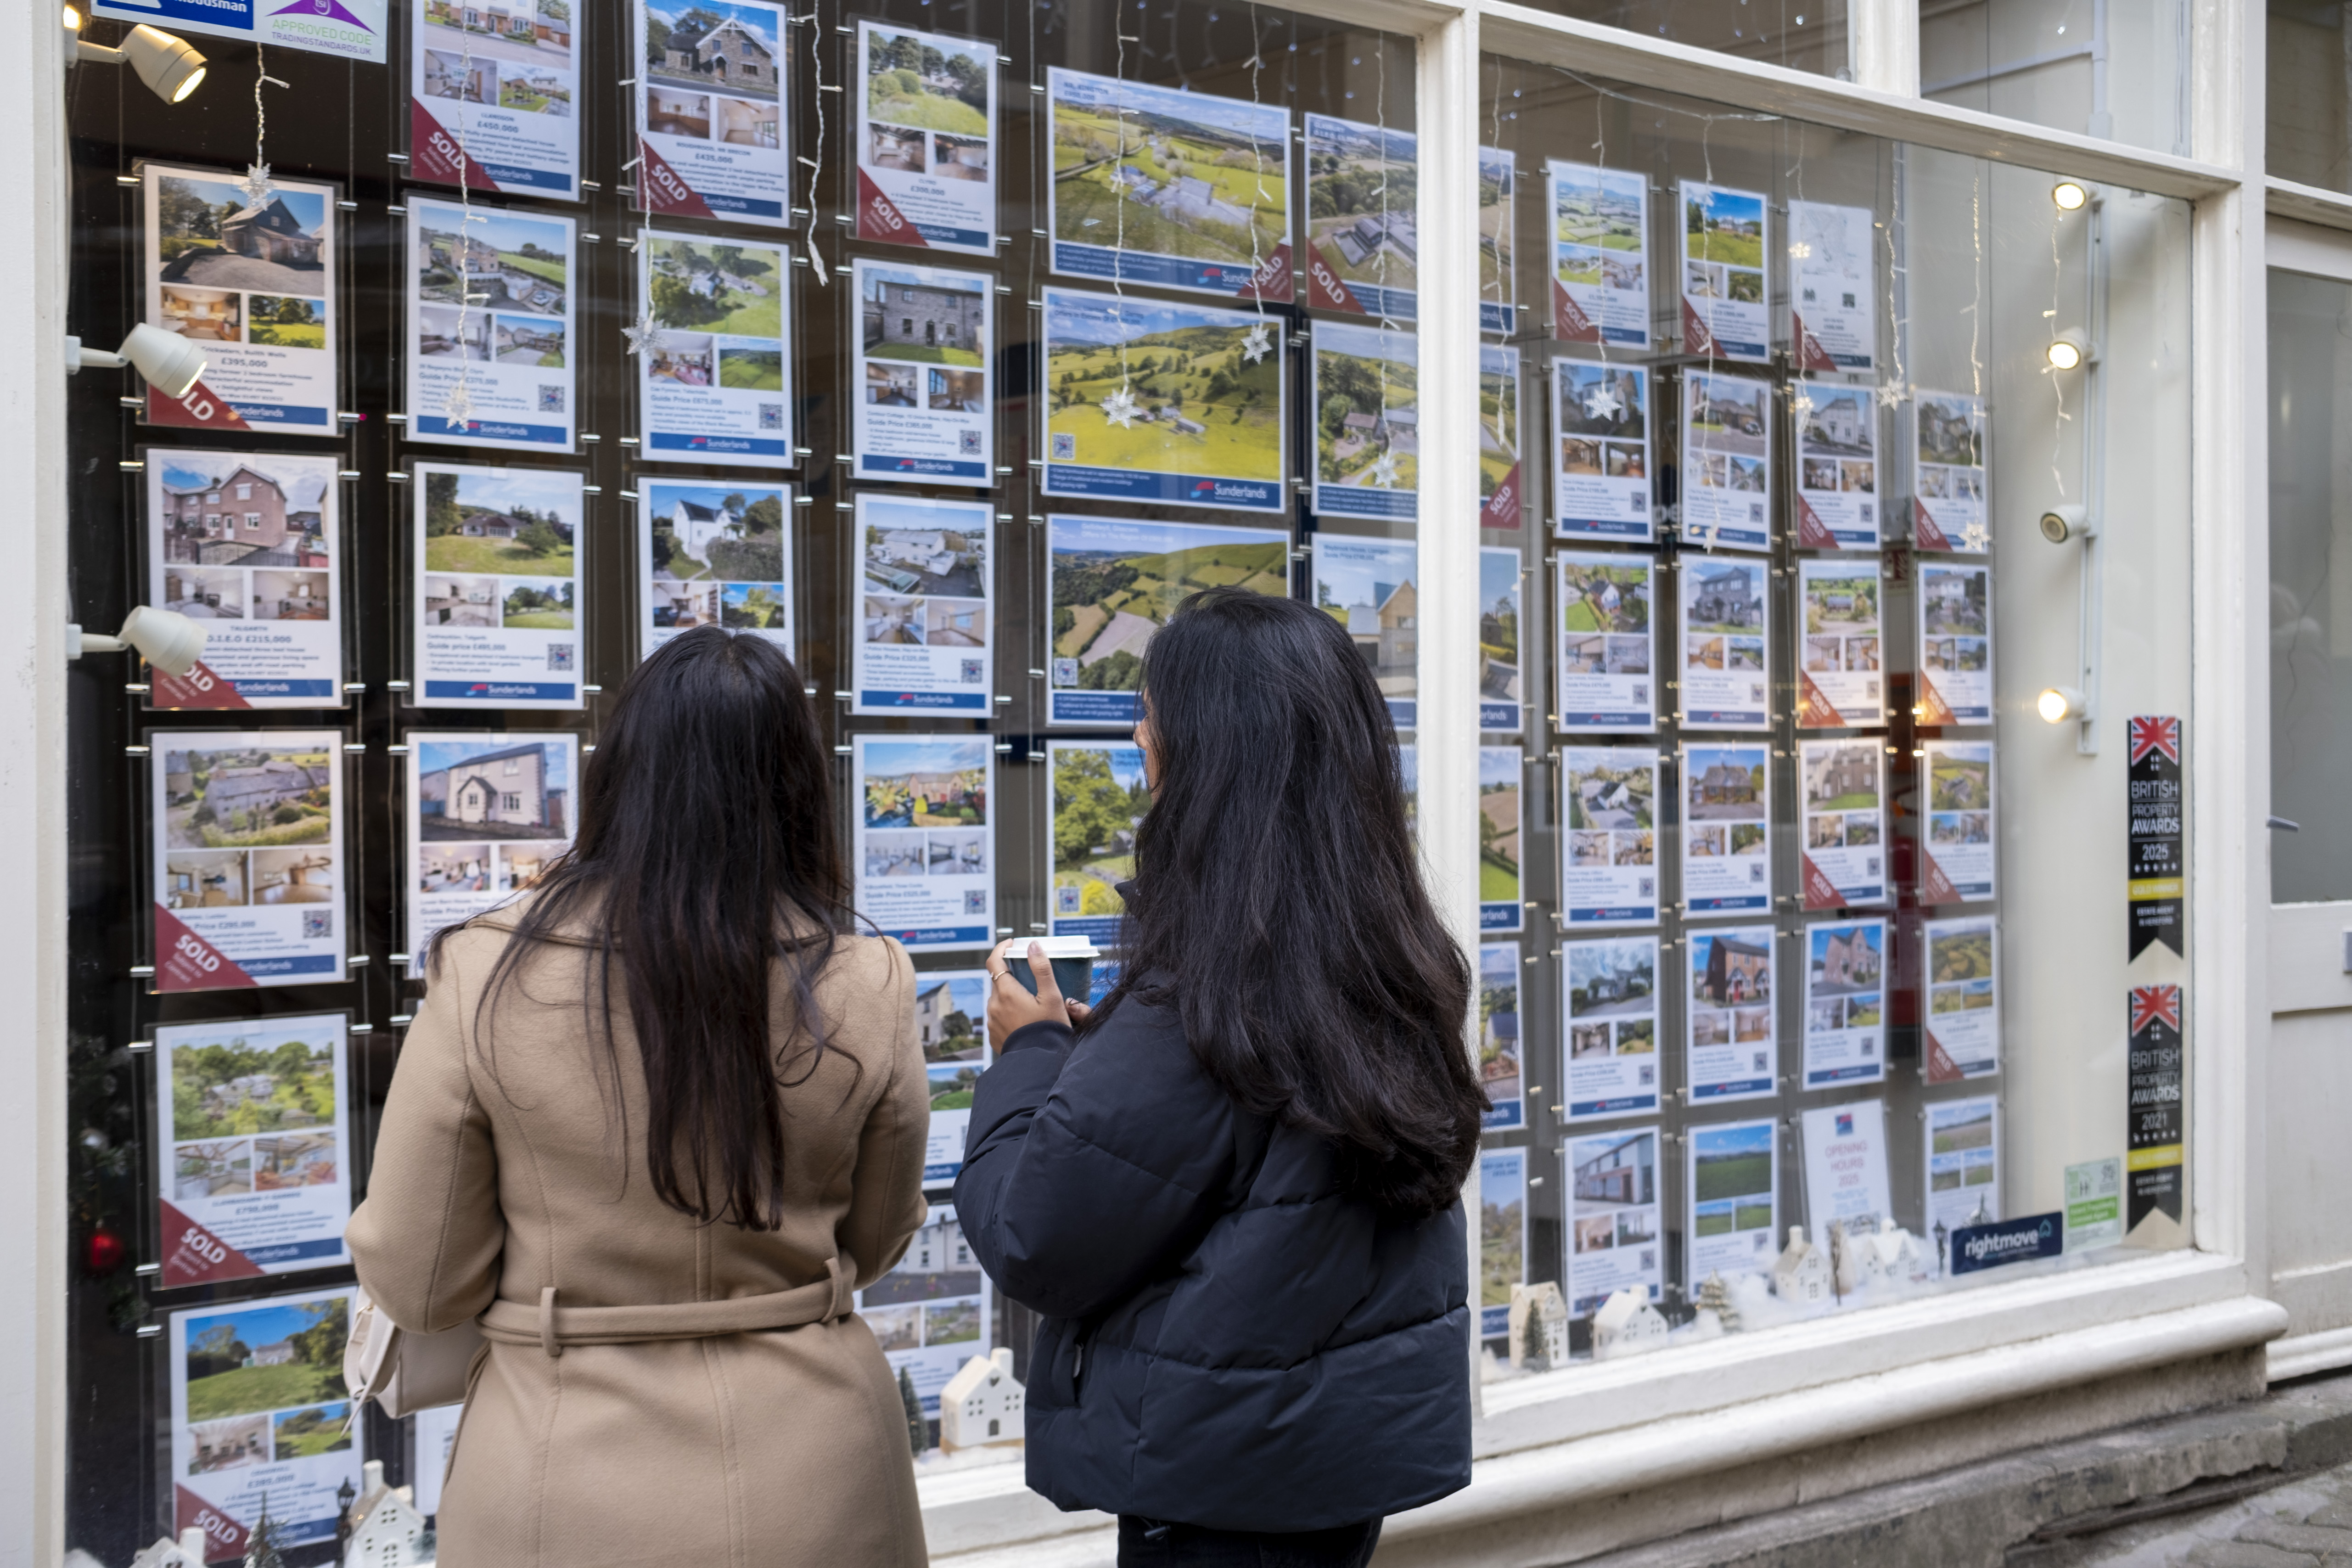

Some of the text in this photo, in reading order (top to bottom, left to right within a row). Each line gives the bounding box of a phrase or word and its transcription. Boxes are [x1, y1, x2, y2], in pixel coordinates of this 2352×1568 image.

[174, 0, 247, 12] budsman
[272, 18, 371, 45] APPROVED CODE
[271, 31, 371, 56] TRADINGSTANDARDS.UK
[477, 121, 519, 133] £450,000
[428, 131, 462, 169] SOLD
[695, 153, 734, 164] £435,000
[484, 166, 533, 181] Sunderlands
[651, 164, 687, 201] SOLD
[703, 195, 747, 209] Sunderlands
[871, 196, 903, 230] SOLD
[916, 226, 957, 239] Sunderlands
[1257, 256, 1283, 287] SOLD
[1311, 262, 1345, 304] SOLD
[1564, 302, 1588, 331] SOLD
[1805, 338, 1822, 360] OLD
[221, 357, 268, 368] £395,000
[175, 390, 214, 421] LD
[229, 404, 284, 418] Sunderlands
[479, 423, 528, 436] Sunderlands
[706, 439, 750, 450] Sunderlands
[913, 461, 954, 471] Sunderlands
[1214, 483, 1268, 499] Sunderlands
[1489, 485, 1511, 515] SOLD
[1806, 511, 1825, 538] SOLD
[1920, 514, 1939, 541] SOLD
[245, 635, 292, 644] £215,000
[181, 664, 214, 691] OLD
[235, 681, 290, 692] Sunderlands
[487, 684, 537, 694] Sunderlands
[913, 694, 954, 704] Sunderlands
[1810, 690, 1830, 716] SOLD
[1928, 689, 1946, 715] SOLD
[1480, 708, 1508, 720] erlands
[2131, 780, 2178, 799] BRITISH
[2132, 803, 2180, 818] PROPERTY
[2132, 817, 2180, 835] AWARDS
[2142, 843, 2169, 861] 2025
[1811, 872, 1832, 899] SOLD
[1931, 869, 1950, 894] SOLD
[1481, 909, 1508, 921] erlands
[916, 931, 957, 939] Sunderlands
[174, 934, 220, 972] SOLD
[236, 960, 292, 972] Sunderlands
[1934, 1047, 1952, 1072] SOLD
[2131, 1048, 2179, 1070] BRITISH
[2132, 1069, 2179, 1087] PROPERTY
[2132, 1085, 2180, 1106] AWARDS
[2141, 1112, 2168, 1130] 2021
[1825, 1140, 1868, 1158] OPENING
[1830, 1157, 1864, 1173] HOURS
[1838, 1173, 1860, 1187] 2025
[180, 1227, 227, 1264] SOLD
[242, 1246, 300, 1260] Sunderlands
[1965, 1228, 2039, 1260] rightmove
[193, 1508, 239, 1544] SOLD
